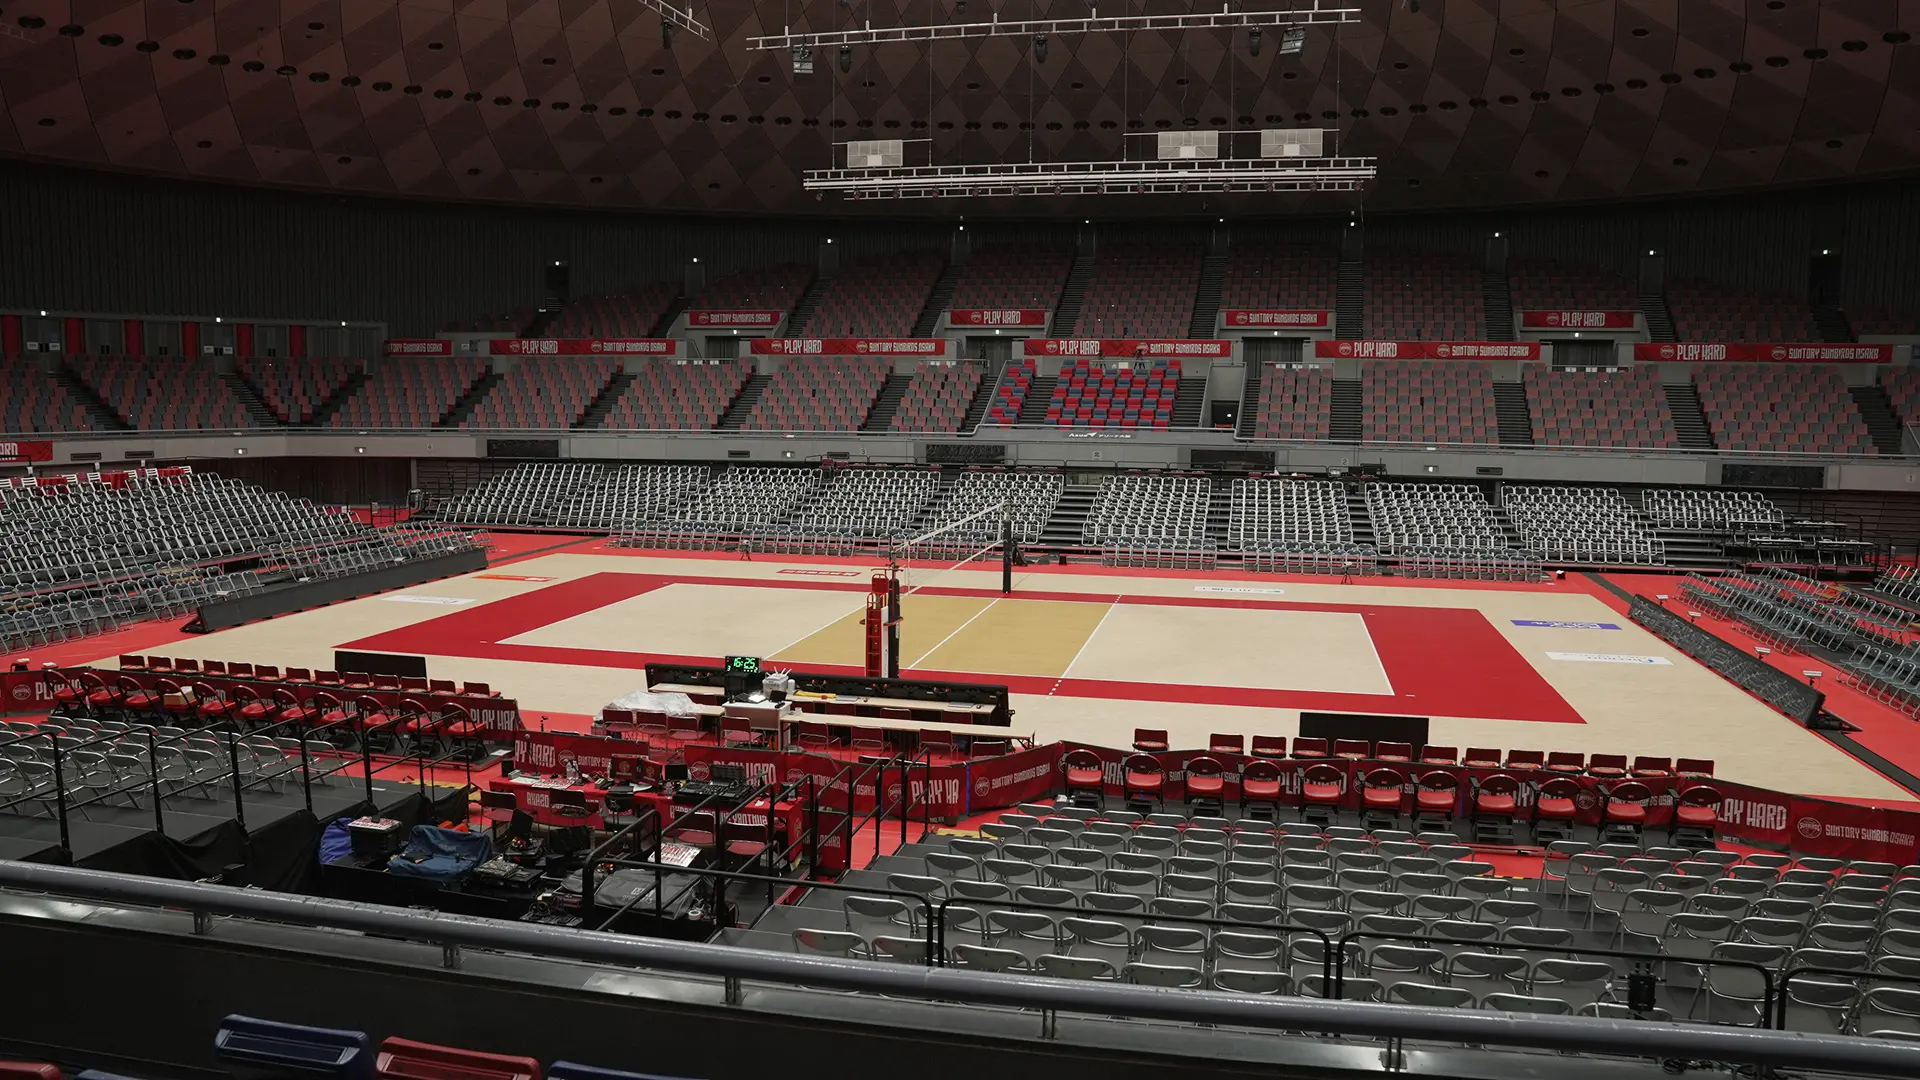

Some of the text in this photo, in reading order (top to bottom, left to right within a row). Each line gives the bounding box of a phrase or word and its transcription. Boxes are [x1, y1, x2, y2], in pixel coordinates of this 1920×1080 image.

[983, 310, 1021, 324] PLAY HARD
[1249, 313, 1318, 323] SUNTORY SUNBIRDS OSAKA
[1561, 312, 1606, 327] PLAY HARD
[521, 340, 559, 354] PLAY HARD
[603, 342, 667, 352] SUNTORY SUNBIRDS OSAKA
[784, 340, 823, 354] PLAY HARD
[869, 342, 936, 353] SUNTORY SUNBIRDS OSAKA
[1059, 340, 1100, 355] PLAY HARD
[1149, 343, 1221, 354] SUNTORY SUNBIRDS OSAKA
[1353, 342, 1398, 357] PLAY HARD
[1451, 345, 1530, 357] SUNTORY SUNBIRDS OSAKA
[1676, 344, 1727, 361] PLAY HARD
[1788, 347, 1879, 360] SUNTORY SUNBIRDS OSAKA
[733, 657, 756, 669] 16:25
[529, 742, 557, 768] HARD
[577, 755, 602, 768] SUNTORY
[991, 773, 1013, 790] SUNTORY
[856, 784, 876, 796] OSAKA
[910, 779, 944, 805] PLAY
[1746, 801, 1788, 831] HARD
[1825, 823, 1861, 840] SUNTORY
[1889, 831, 1916, 848] OSAKA
